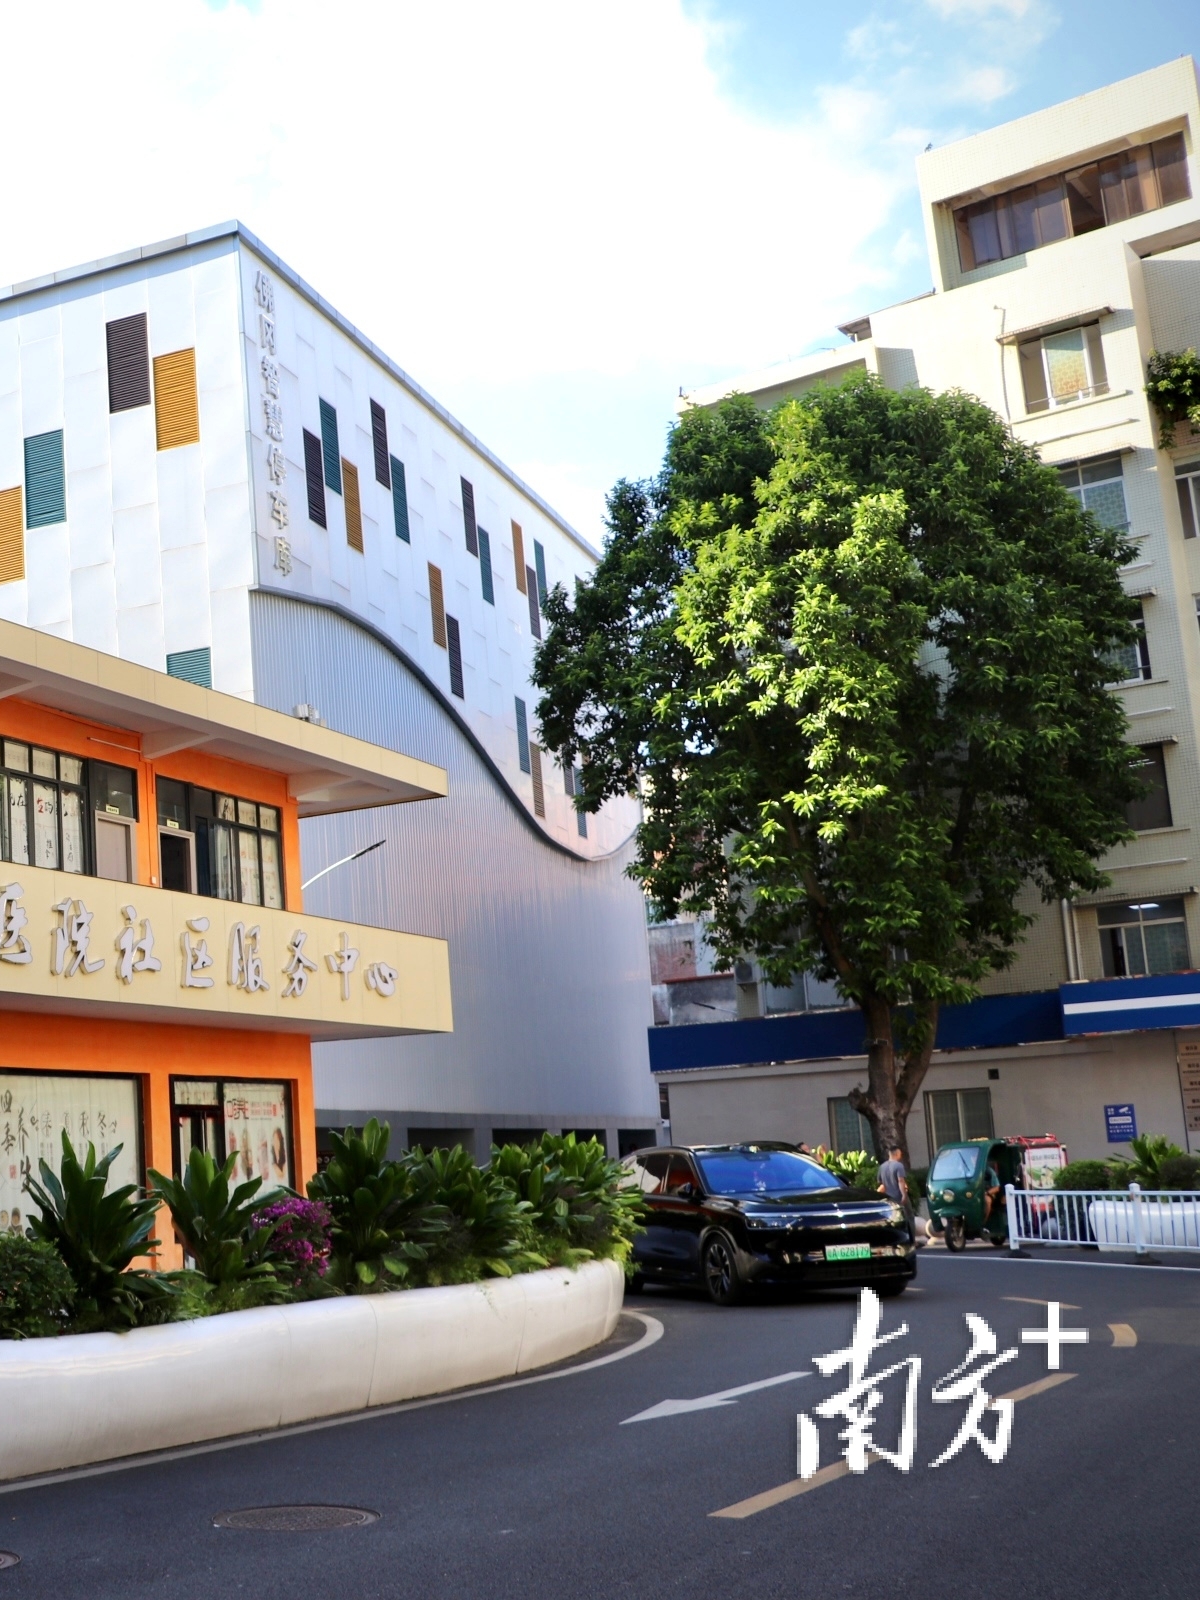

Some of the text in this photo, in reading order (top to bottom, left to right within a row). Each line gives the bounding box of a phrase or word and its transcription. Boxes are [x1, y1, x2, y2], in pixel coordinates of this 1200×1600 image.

[254, 269, 294, 577] 佛冈智慧停车库
